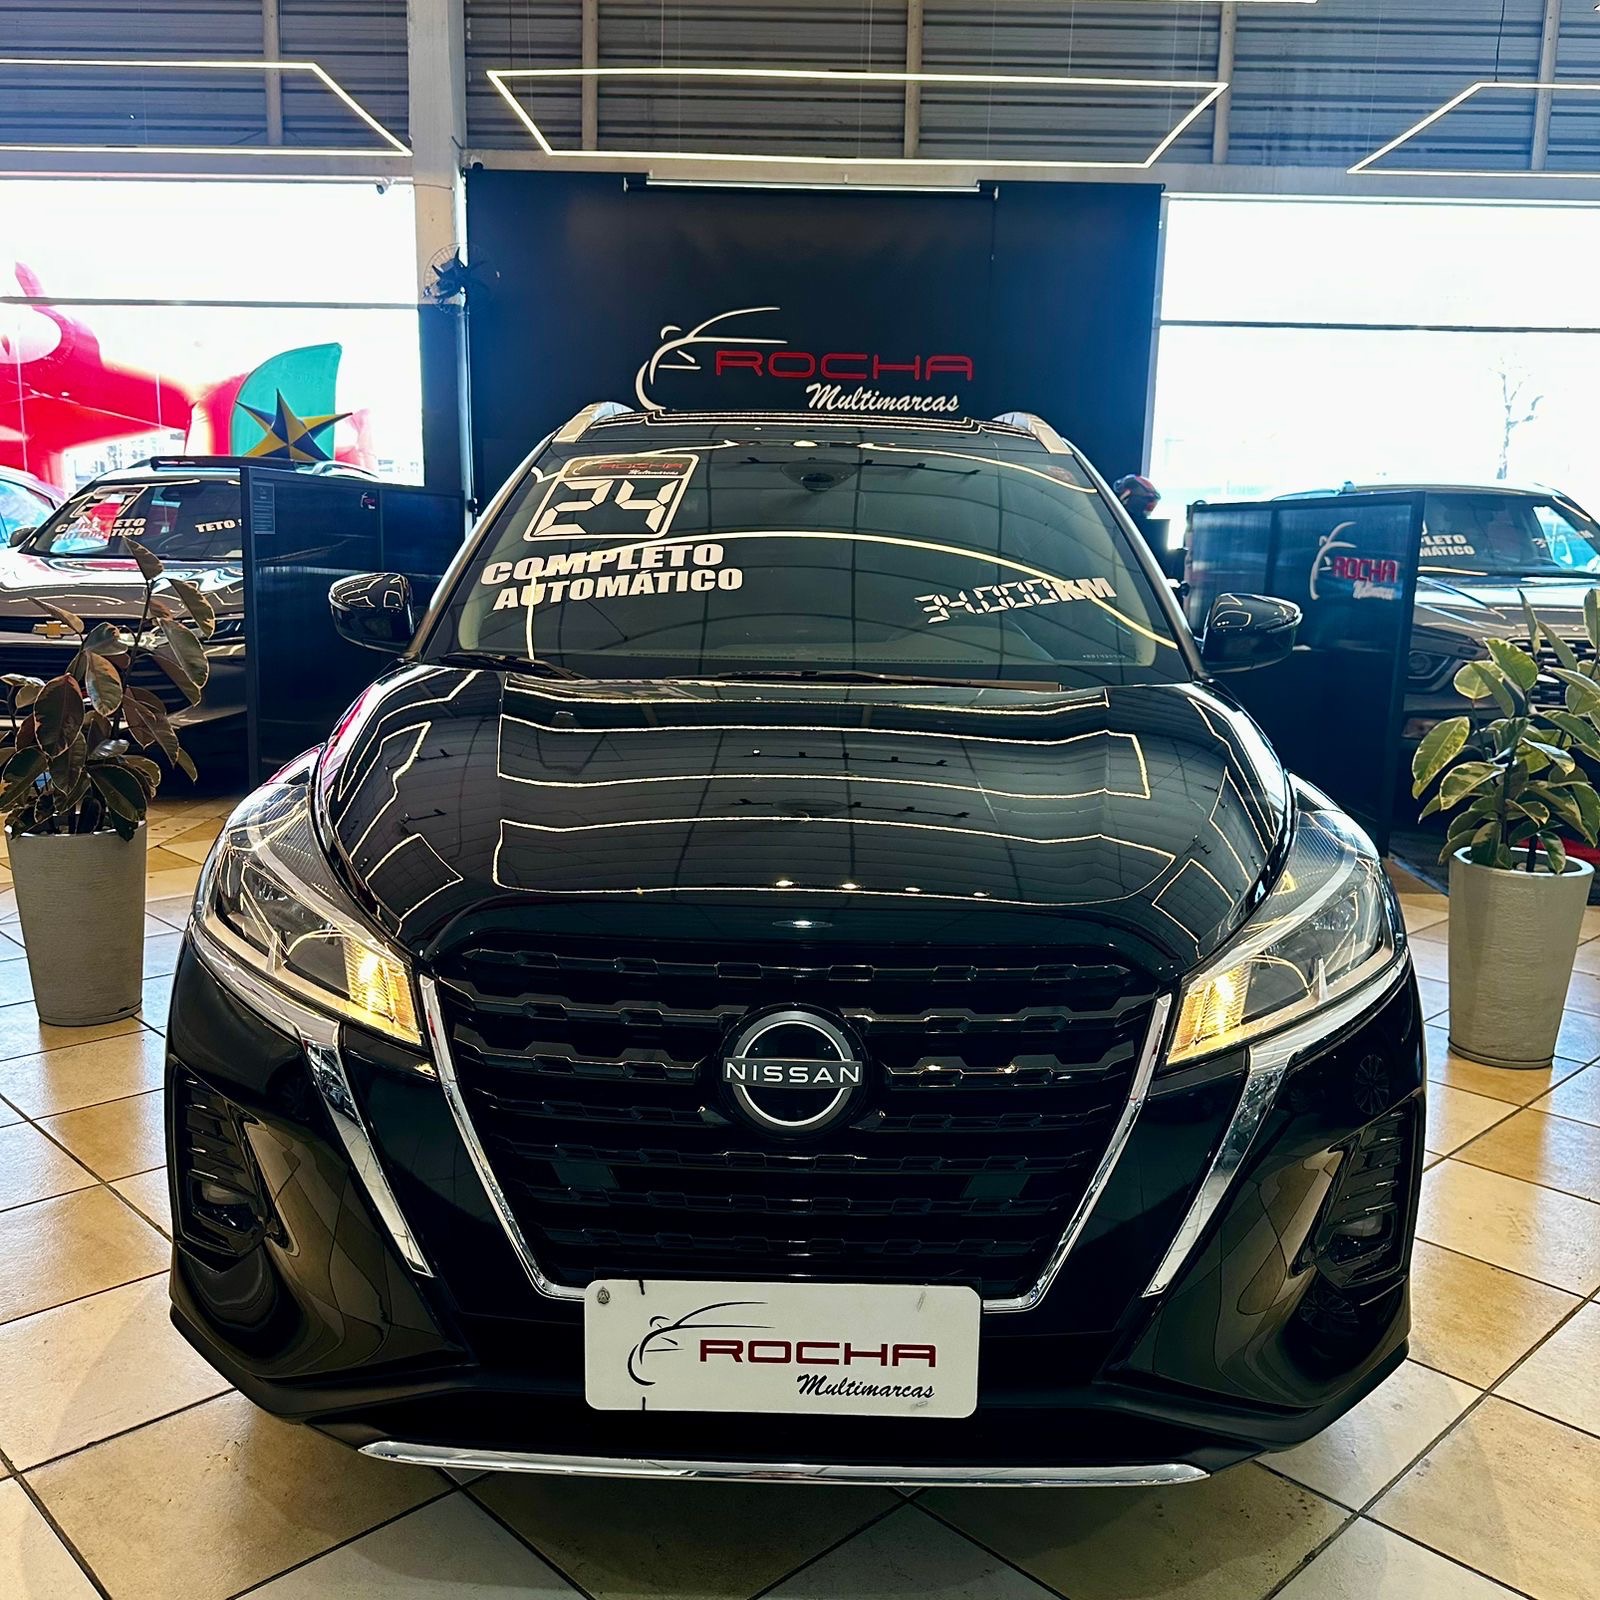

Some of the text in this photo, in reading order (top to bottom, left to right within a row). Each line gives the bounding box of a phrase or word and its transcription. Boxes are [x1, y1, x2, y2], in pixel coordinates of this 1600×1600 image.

[715, 350, 973, 381] ROCHA
[805, 383, 960, 412] Multimarcas
[532, 478, 679, 536] 24
[195, 521, 236, 533] TETO
[1420, 534, 1467, 546] LETO
[480, 543, 724, 586] COMPLETO
[1333, 556, 1399, 583] ROCHA
[493, 568, 743, 611] AUTOMÁTICO
[726, 1062, 860, 1084] NISSAN
[699, 1339, 937, 1368] ROCHA
[796, 1374, 935, 1399] Multimarcas
